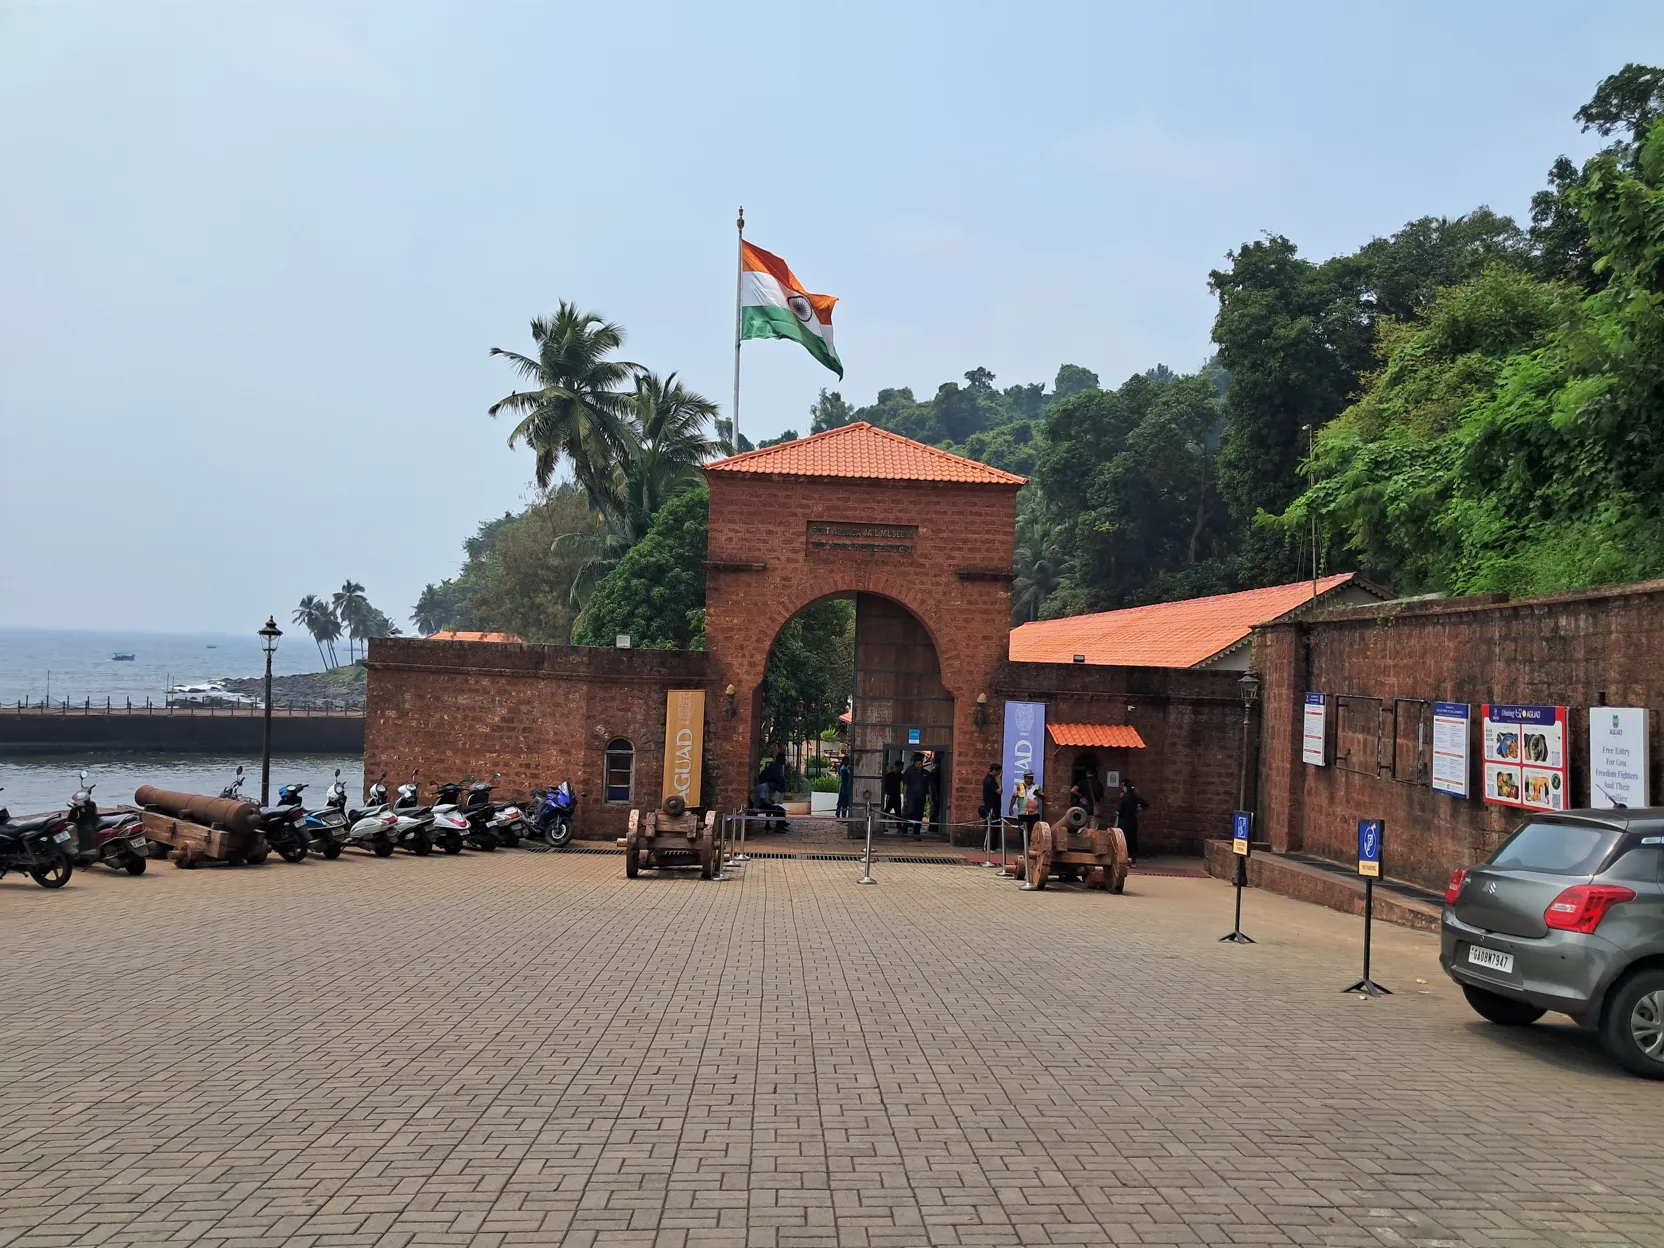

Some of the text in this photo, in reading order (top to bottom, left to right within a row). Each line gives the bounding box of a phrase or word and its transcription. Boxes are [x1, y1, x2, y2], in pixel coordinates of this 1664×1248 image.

[1614, 747, 1630, 756] Entry
[1606, 758, 1627, 767] For Goa
[1595, 769, 1639, 780] Freedom Fighters
[1604, 781, 1630, 791] And Their
